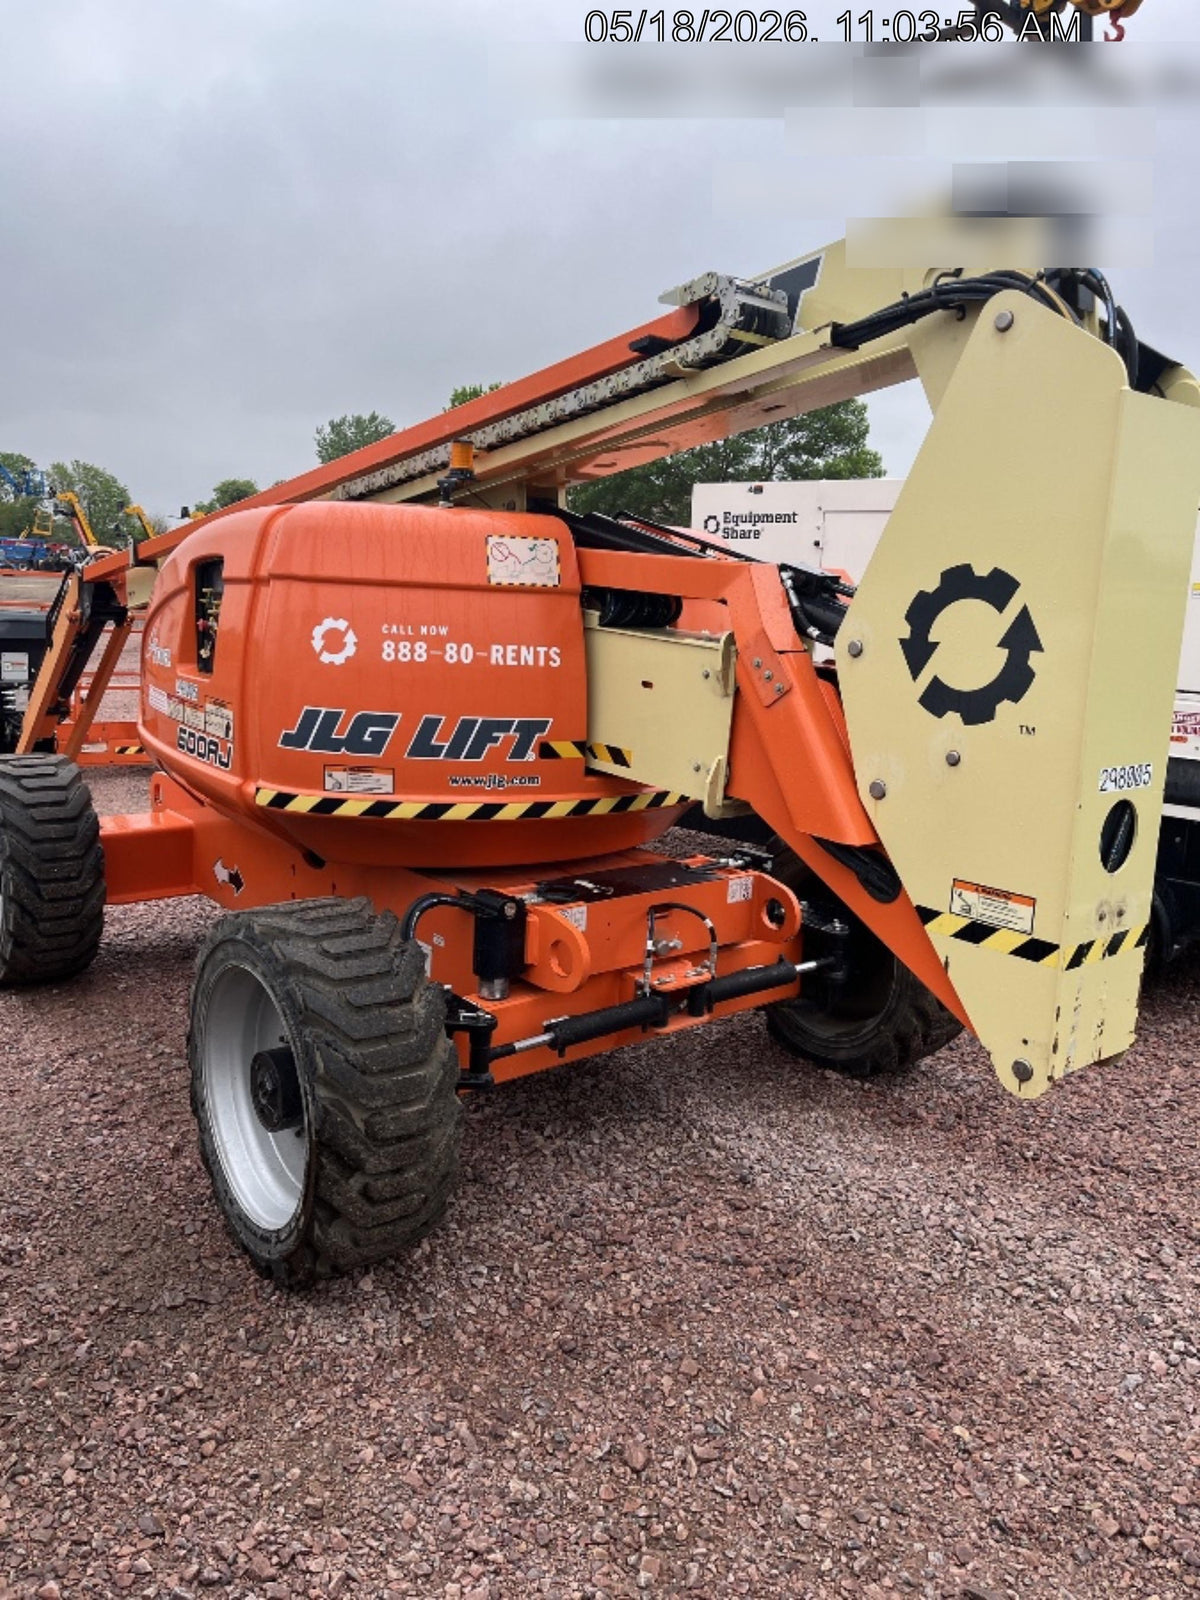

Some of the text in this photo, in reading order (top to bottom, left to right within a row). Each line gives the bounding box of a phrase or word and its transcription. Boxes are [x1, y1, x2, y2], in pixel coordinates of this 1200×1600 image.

[722, 511, 798, 526] Equipment
[381, 624, 450, 637] CALL NOW
[381, 641, 562, 668] 888-80-RENTS
[278, 706, 403, 757] JLG
[448, 773, 541, 790] www.jlg.com
[1099, 763, 1152, 792] 298005
